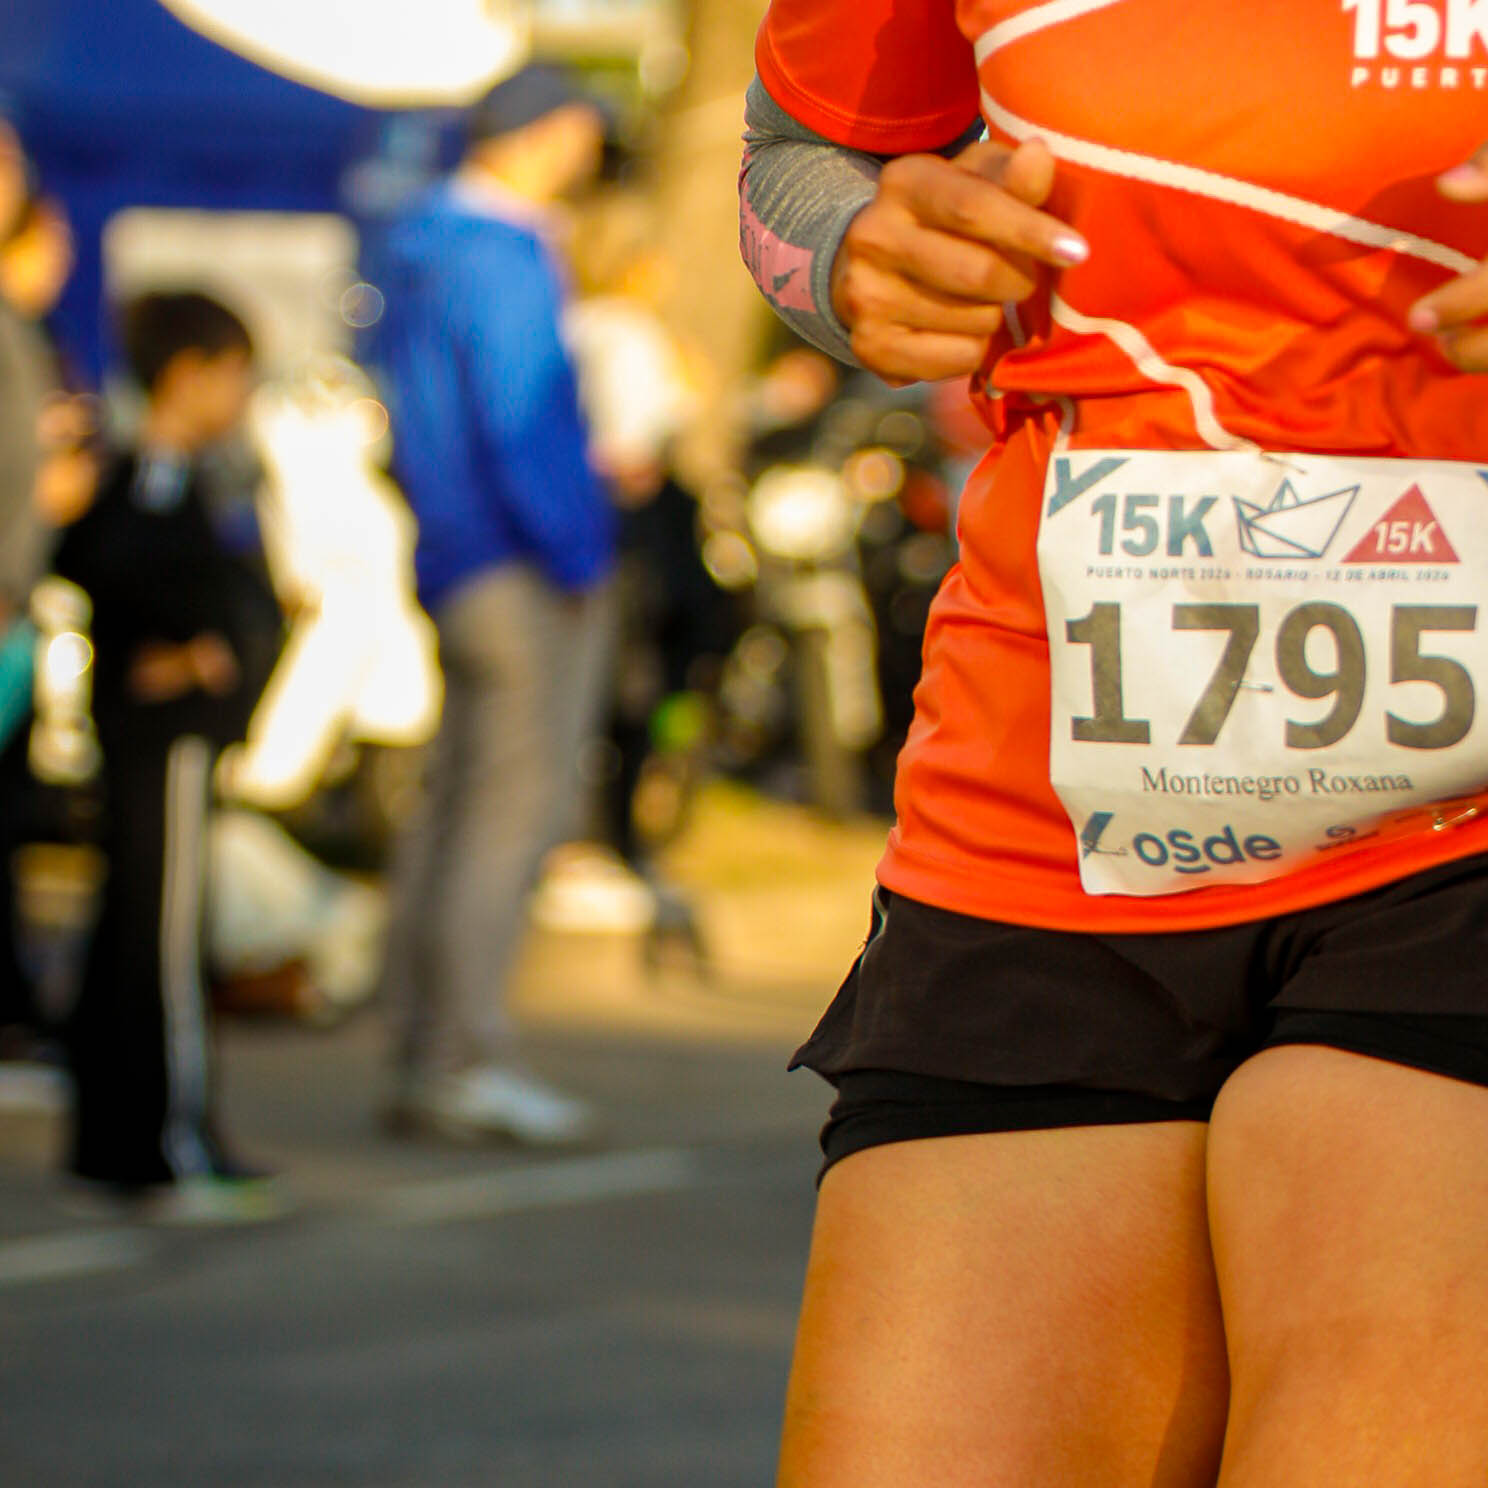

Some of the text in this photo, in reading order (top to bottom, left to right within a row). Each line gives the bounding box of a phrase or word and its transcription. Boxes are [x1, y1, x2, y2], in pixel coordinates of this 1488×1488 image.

[1089, 493, 1219, 557] 15K
[1373, 520, 1438, 555] 15K
[1086, 565, 1143, 579] PUERTO
[1149, 566, 1196, 580] NORTE
[1246, 567, 1309, 581] ROSARIO
[1345, 568, 1364, 582] DE
[1367, 568, 1409, 582] ABRIL
[1064, 600, 1479, 750] 1795
[1141, 766, 1414, 800] Montenegro Roxana
[1133, 824, 1282, 874] osde
